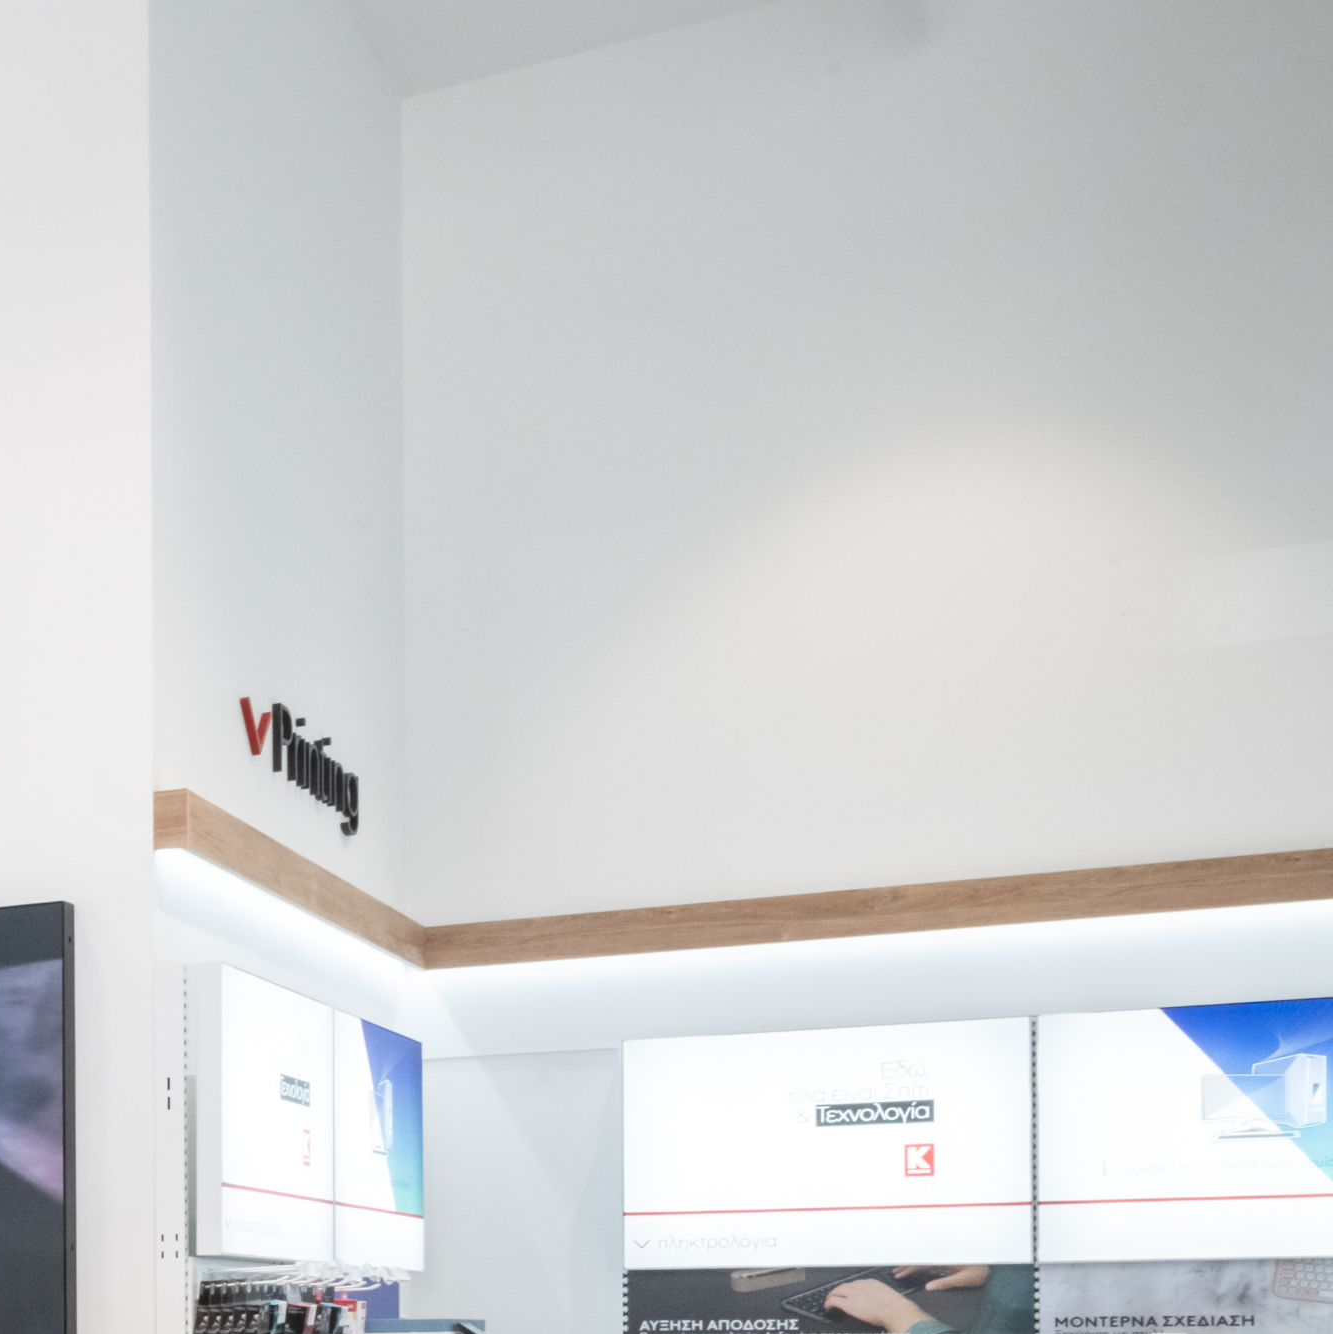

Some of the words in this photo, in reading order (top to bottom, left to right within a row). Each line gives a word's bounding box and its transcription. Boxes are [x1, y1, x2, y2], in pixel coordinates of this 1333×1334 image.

[272, 703, 358, 836] Printing
[815, 1101, 931, 1124] Τεχνολογία
[658, 1234, 777, 1251] πληκτρολόγια
[639, 1319, 704, 1331] ΑΥΞΗΣΗ
[707, 1318, 799, 1331] ΑΠΟΔΟΣΗΣ
[1054, 1315, 1158, 1328] ΜΟΝΤΕΡΝΑ
[1162, 1315, 1255, 1327] ΣΧΕΔΙΑΣΗ
